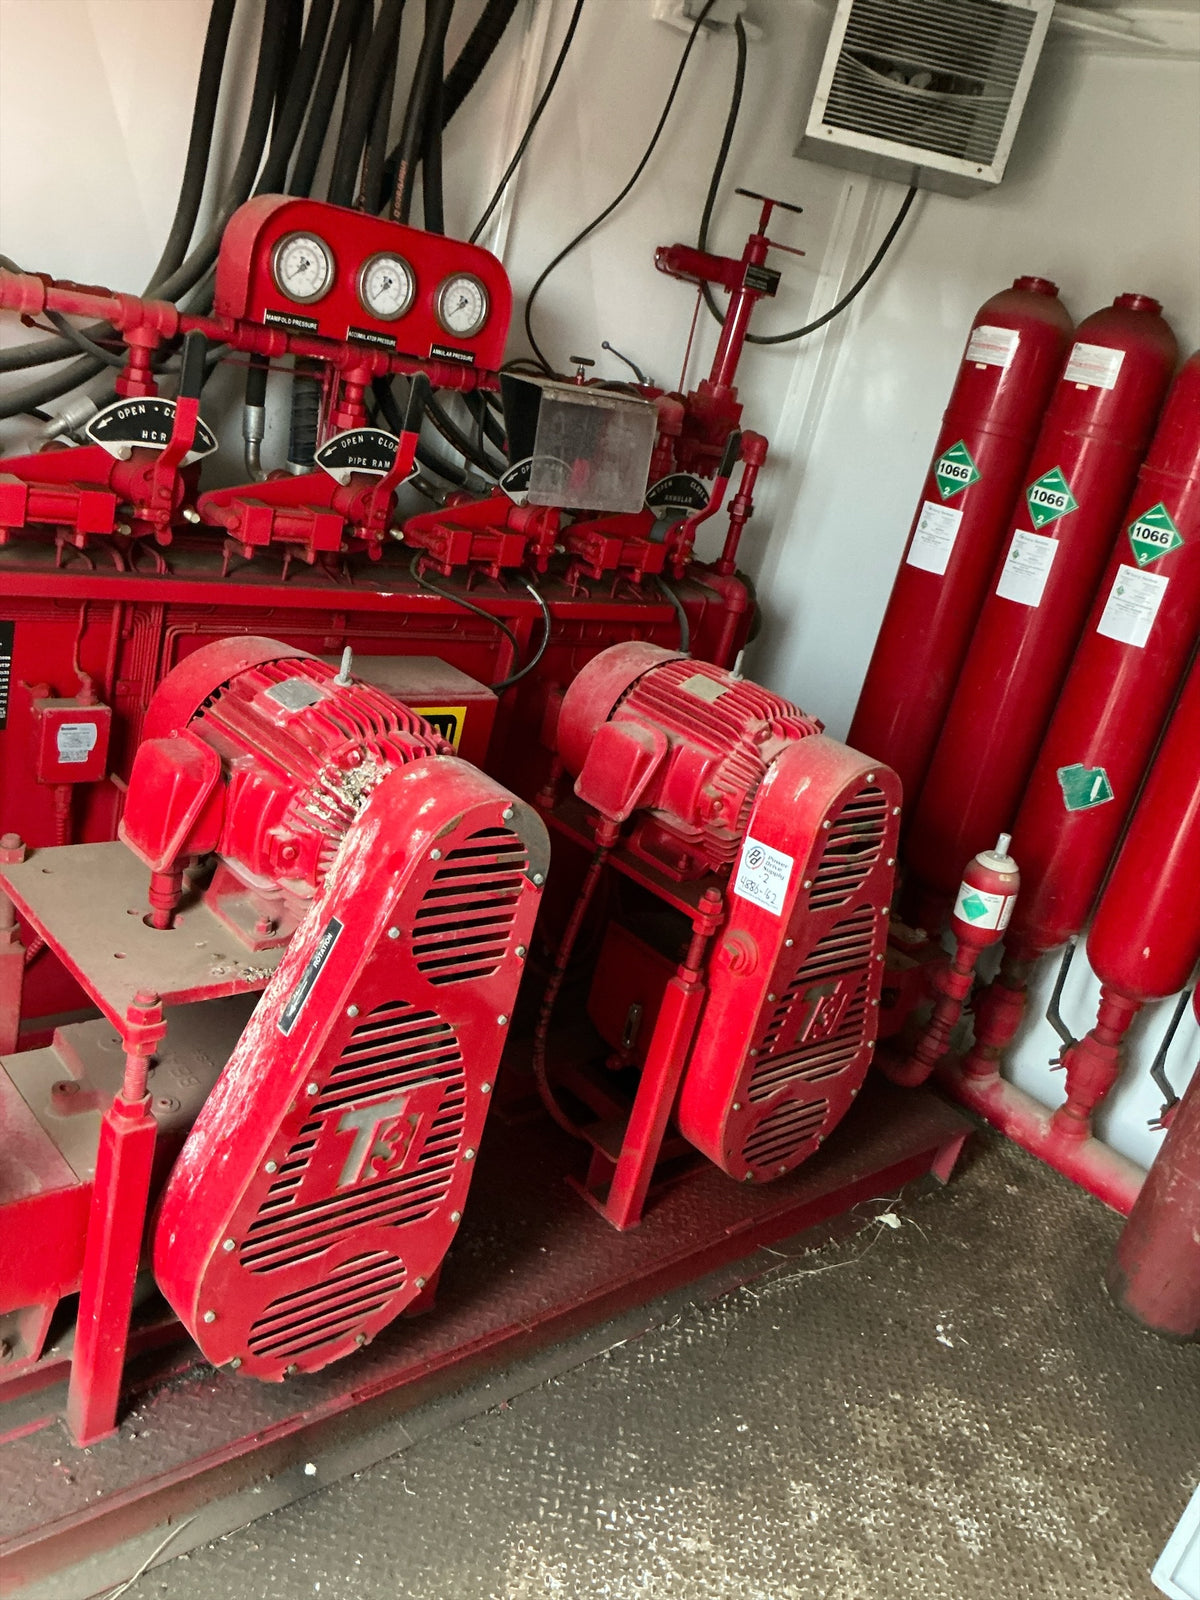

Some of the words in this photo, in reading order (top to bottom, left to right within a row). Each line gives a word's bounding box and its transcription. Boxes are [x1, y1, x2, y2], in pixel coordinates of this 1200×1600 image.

[266, 314, 292, 325] MANIFOLD
[292, 318, 318, 330] PRESSURE
[377, 337, 397, 347] PRESSURE
[432, 348, 452, 357] ANNULAR
[452, 352, 474, 362] PRESSURE
[117, 404, 146, 420] OPEN
[142, 430, 167, 441] HCR
[341, 434, 364, 449] OPEN
[378, 437, 399, 453] CLOS
[348, 456, 367, 466] PIPE
[372, 459, 391, 468] RAM
[940, 462, 969, 480] 1066
[656, 480, 673, 493] OPEN
[943, 486, 951, 496] 2
[1033, 489, 1065, 507] 1066
[1036, 515, 1045, 524] 2
[1136, 526, 1169, 544] 1066
[1139, 552, 1148, 562] 2
[312, 932, 333, 969] ROTATION
